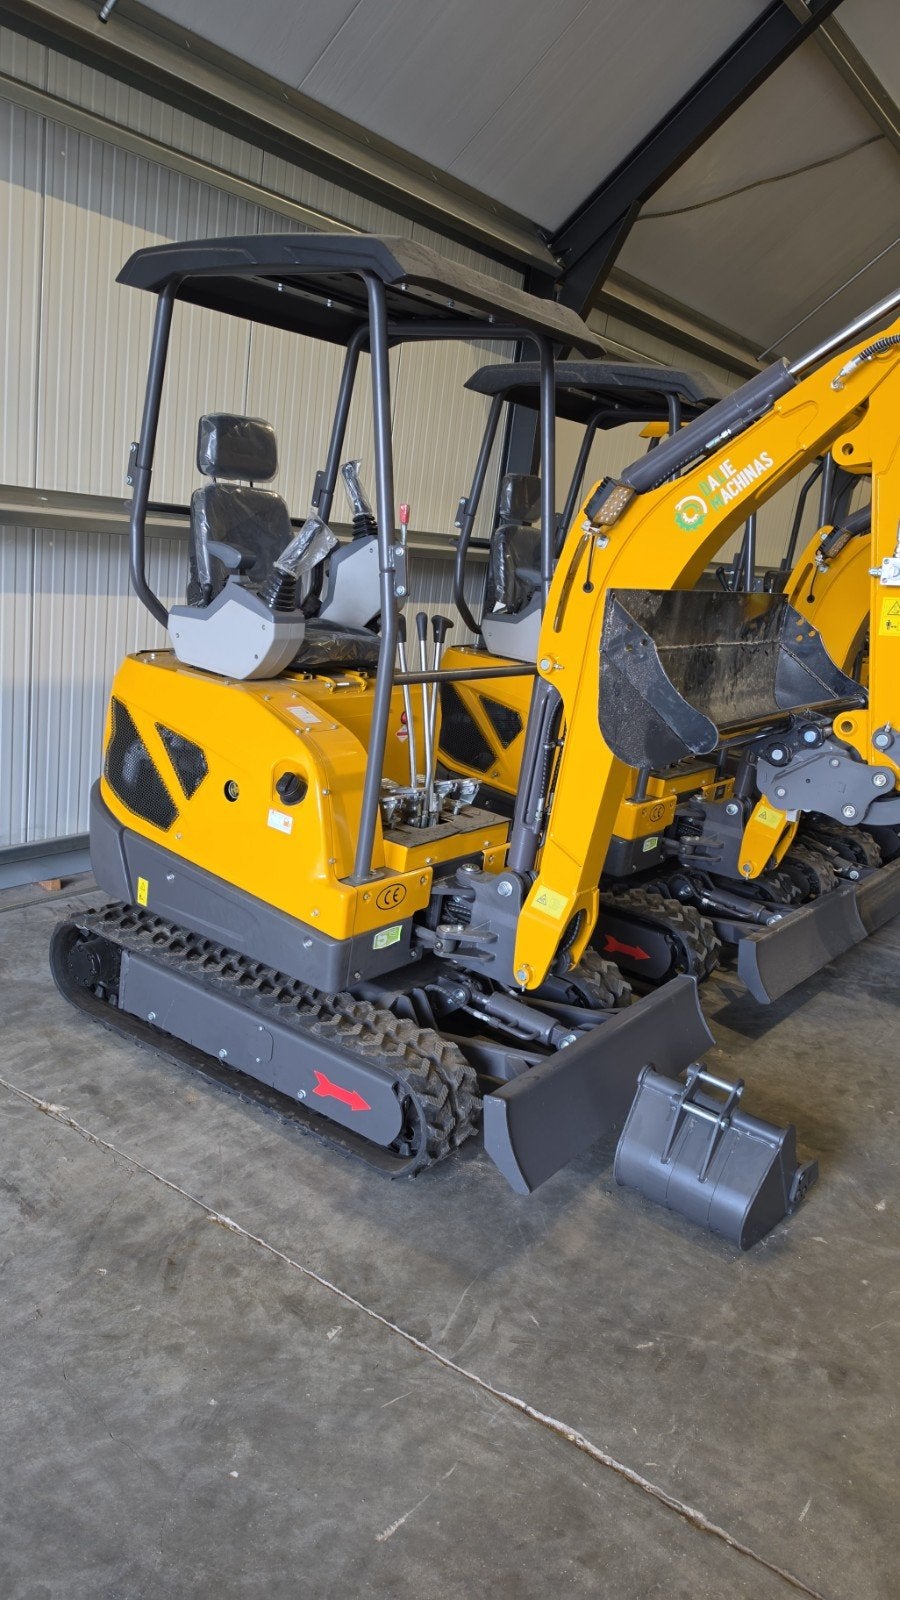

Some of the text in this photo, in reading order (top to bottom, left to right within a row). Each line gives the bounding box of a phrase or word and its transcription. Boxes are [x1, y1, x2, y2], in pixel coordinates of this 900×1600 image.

[699, 459, 736, 496] DALIE
[710, 452, 774, 512] MACHINAS
[384, 887, 400, 905] CE
